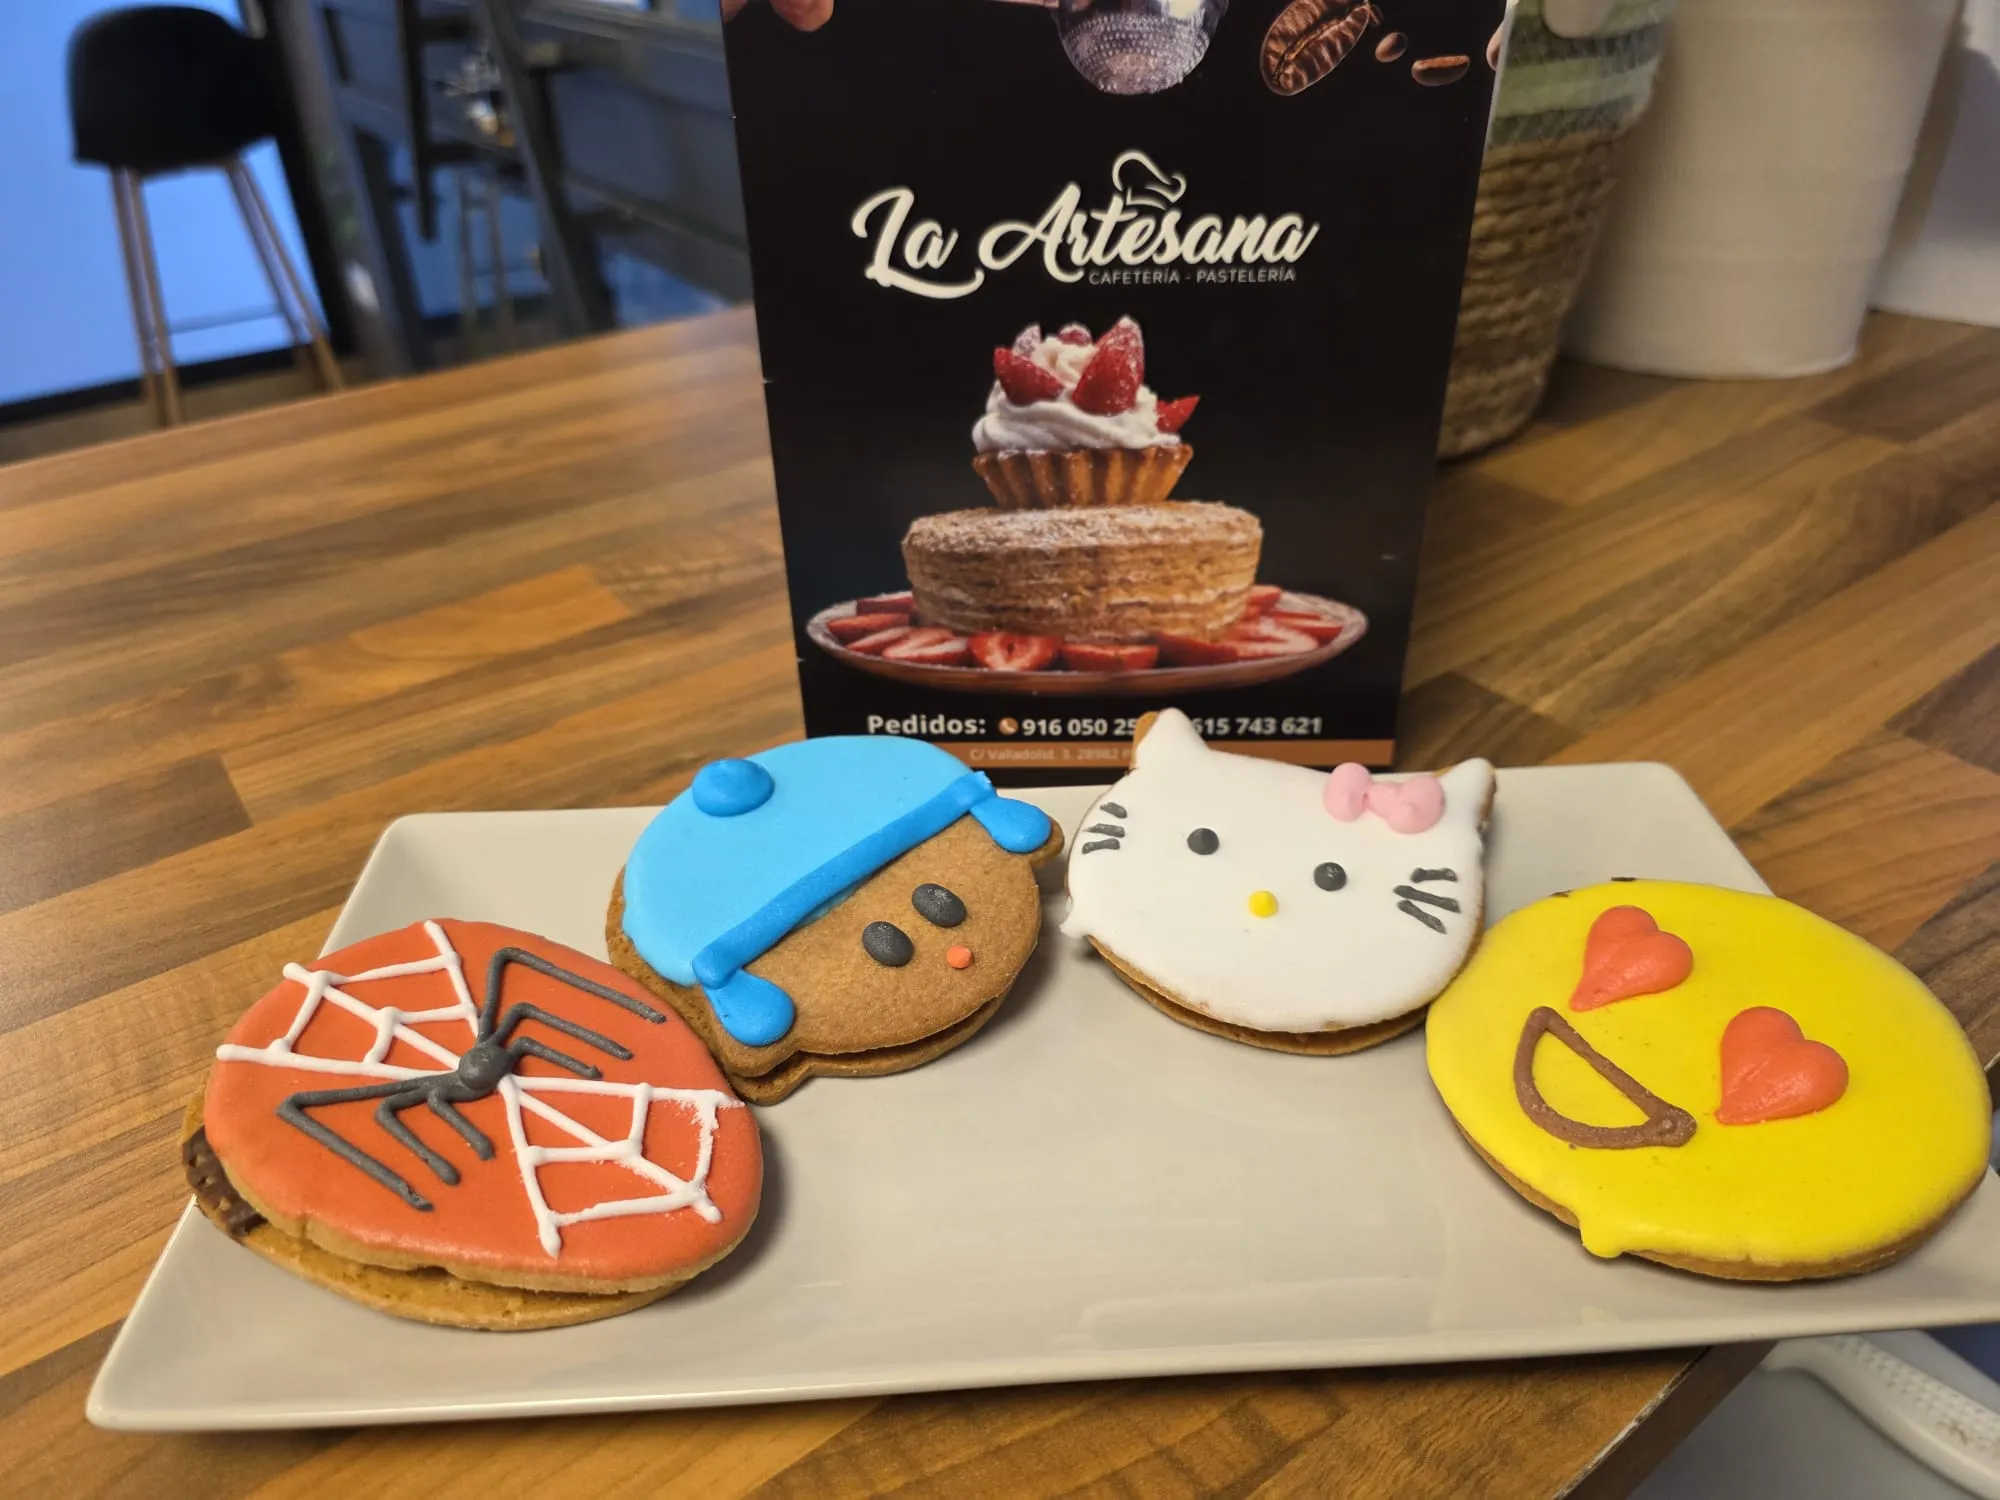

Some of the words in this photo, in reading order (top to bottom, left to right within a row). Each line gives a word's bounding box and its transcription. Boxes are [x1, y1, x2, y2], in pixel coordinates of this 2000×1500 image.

[851, 187, 985, 300] La
[978, 182, 1320, 283] Artesana
[1088, 267, 1180, 285] CAFETERÍA
[1196, 265, 1297, 283] PASTELERÍA
[867, 714, 986, 735] Pedidos:
[1021, 717, 1063, 736] 916
[1067, 717, 1108, 735] 050
[1235, 717, 1276, 735] 743
[1281, 716, 1323, 735] 621
